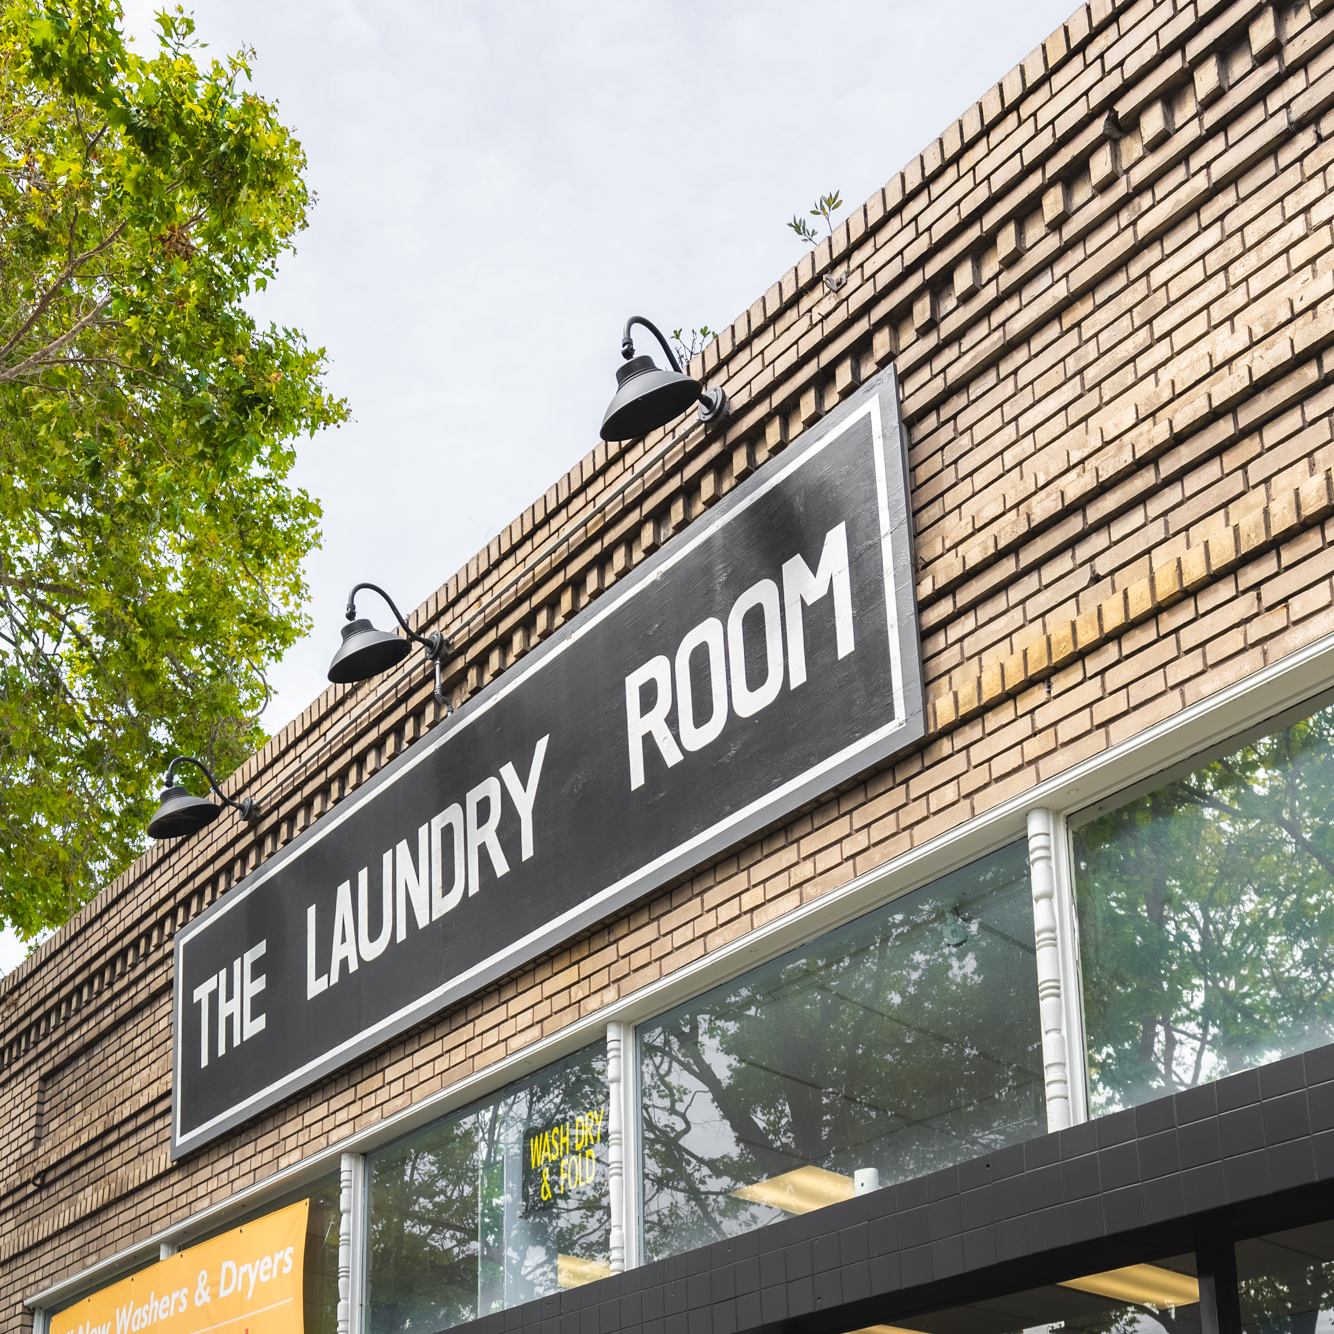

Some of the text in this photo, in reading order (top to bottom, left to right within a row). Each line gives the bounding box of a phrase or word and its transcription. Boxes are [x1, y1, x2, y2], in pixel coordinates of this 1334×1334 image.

[192, 519, 857, 1070] THE LAUNDRY ROOM
[530, 1106, 605, 1170] WASH DRY
[540, 1148, 596, 1201] & FOLD
[194, 1269, 211, 1307] &
[218, 1246, 294, 1300] Dryers
